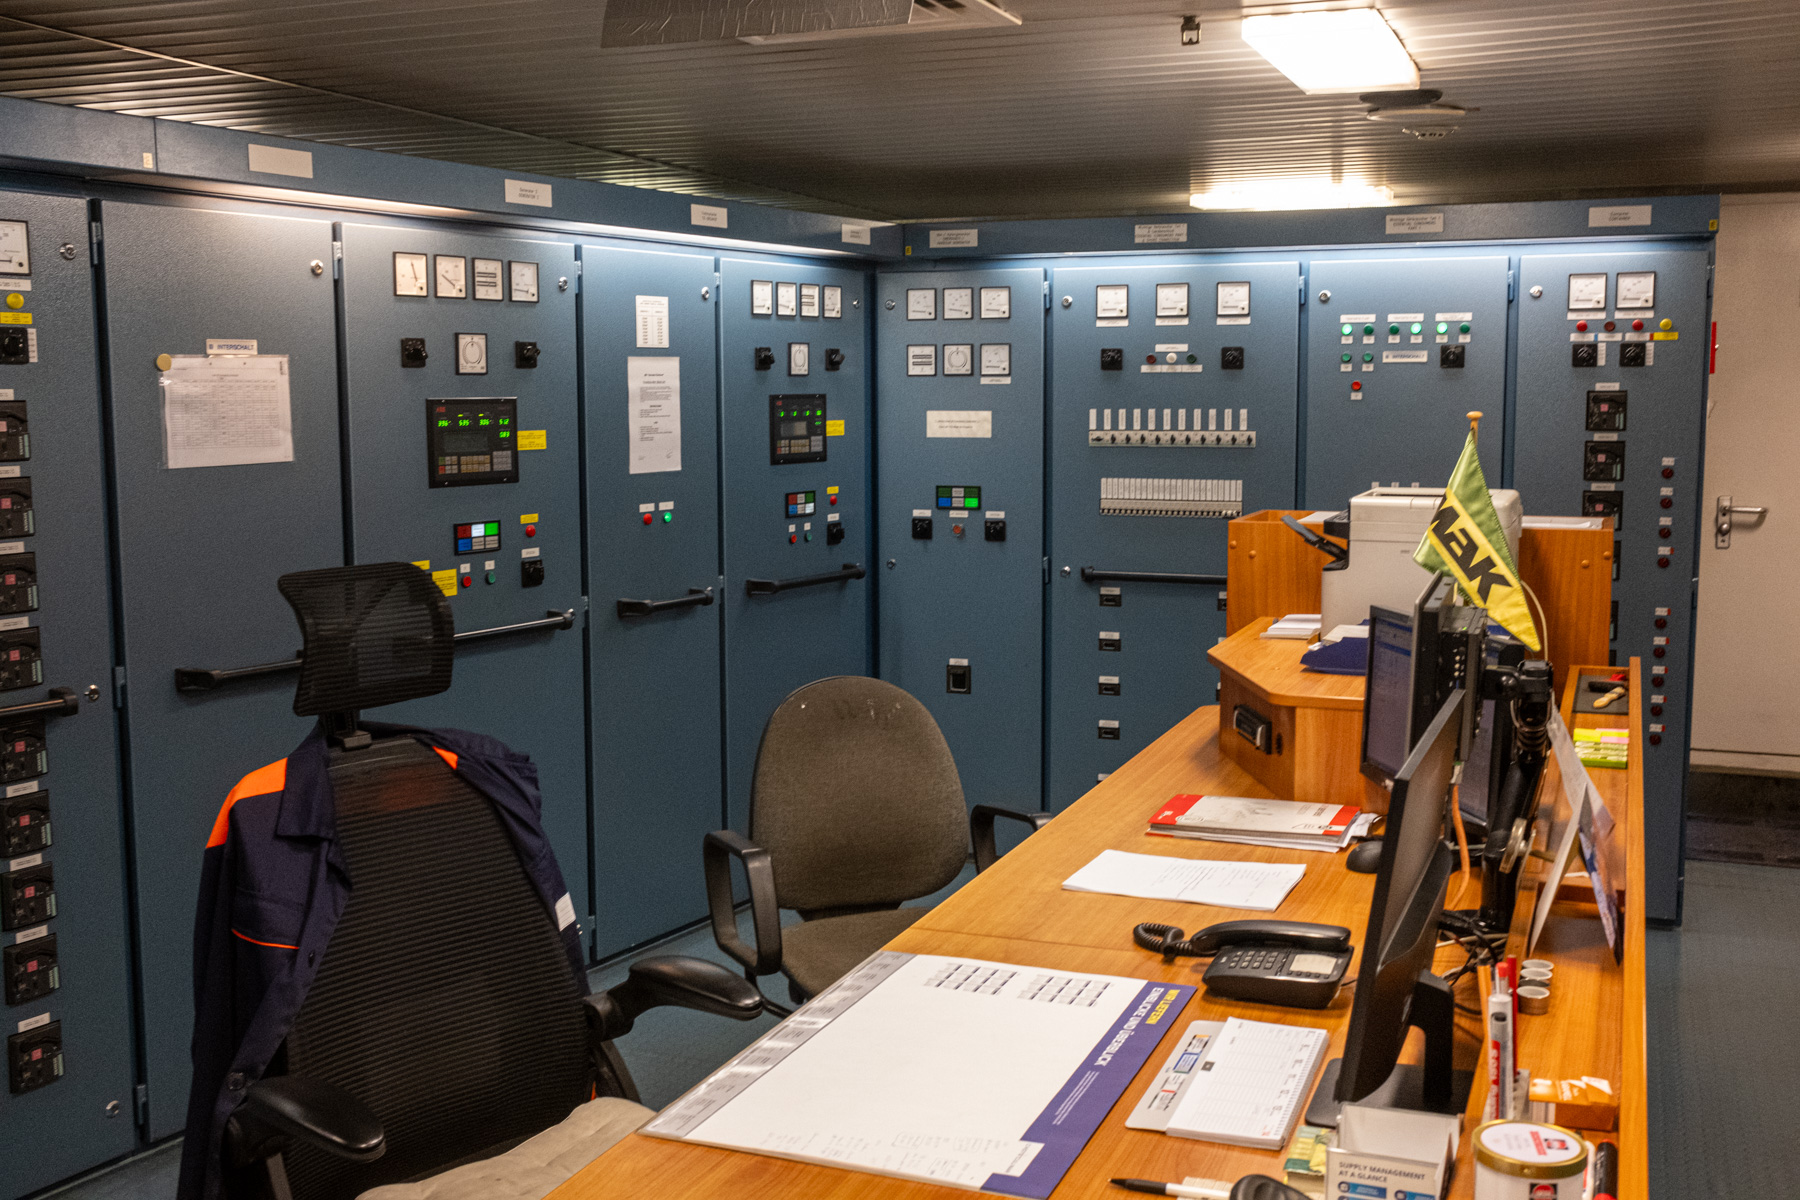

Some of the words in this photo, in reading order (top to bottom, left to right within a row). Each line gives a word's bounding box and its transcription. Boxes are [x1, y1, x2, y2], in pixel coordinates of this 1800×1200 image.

[1123, 1016, 1142, 1030] UND
[1338, 1161, 1368, 1172] SUPPLY
[1369, 1165, 1426, 1181] MANAGEMENT
[1338, 1170, 1349, 1178] AT
[1357, 1173, 1388, 1183] GLANCE
